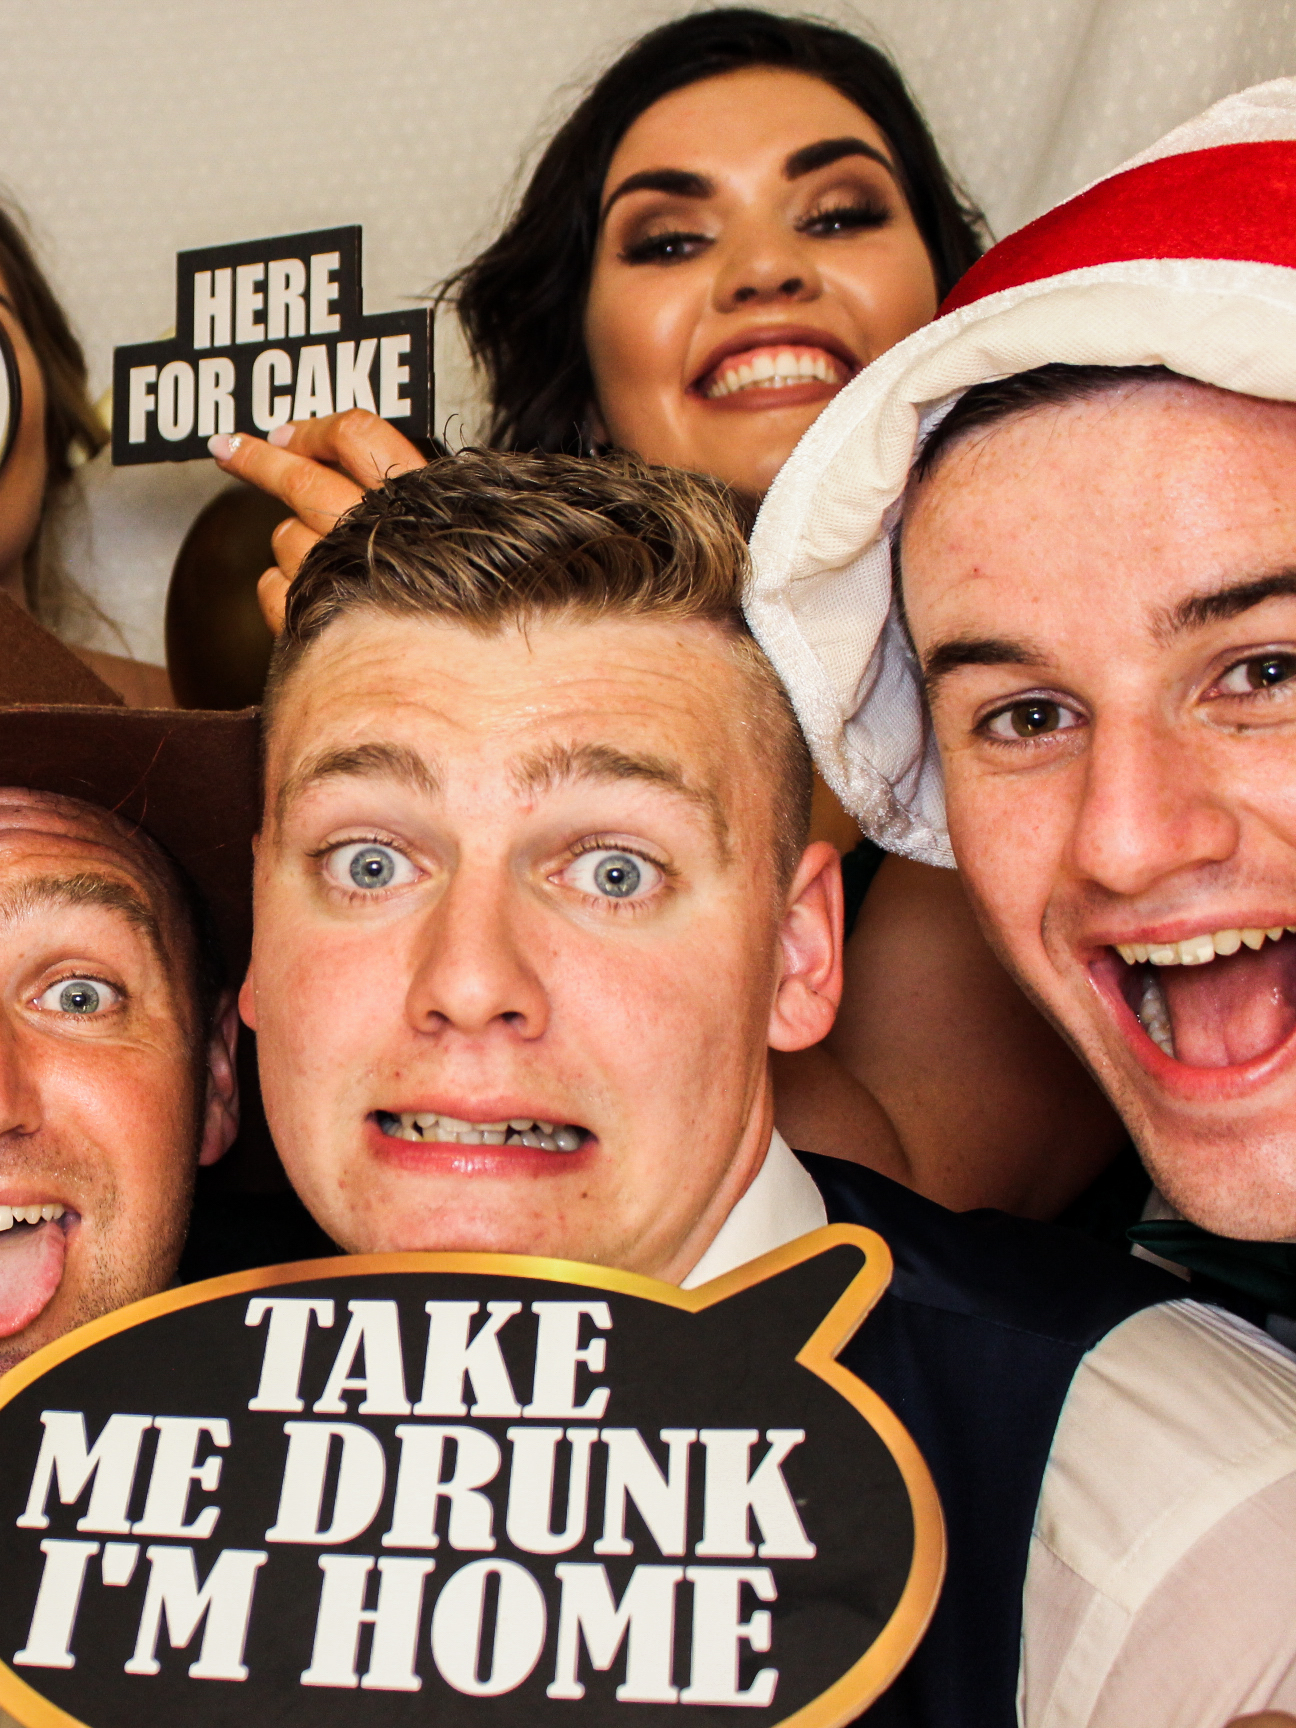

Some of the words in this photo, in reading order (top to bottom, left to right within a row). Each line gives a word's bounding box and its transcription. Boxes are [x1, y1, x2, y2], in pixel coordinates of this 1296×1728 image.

[193, 251, 341, 350] HERE
[128, 356, 236, 444] FOR
[251, 334, 412, 432] CAKE
[245, 1297, 613, 1419] TAKE
[15, 1410, 232, 1539] ME
[264, 1420, 817, 1559] DRUNK
[12, 1538, 269, 1682] I'M
[299, 1553, 779, 1707] HOME
